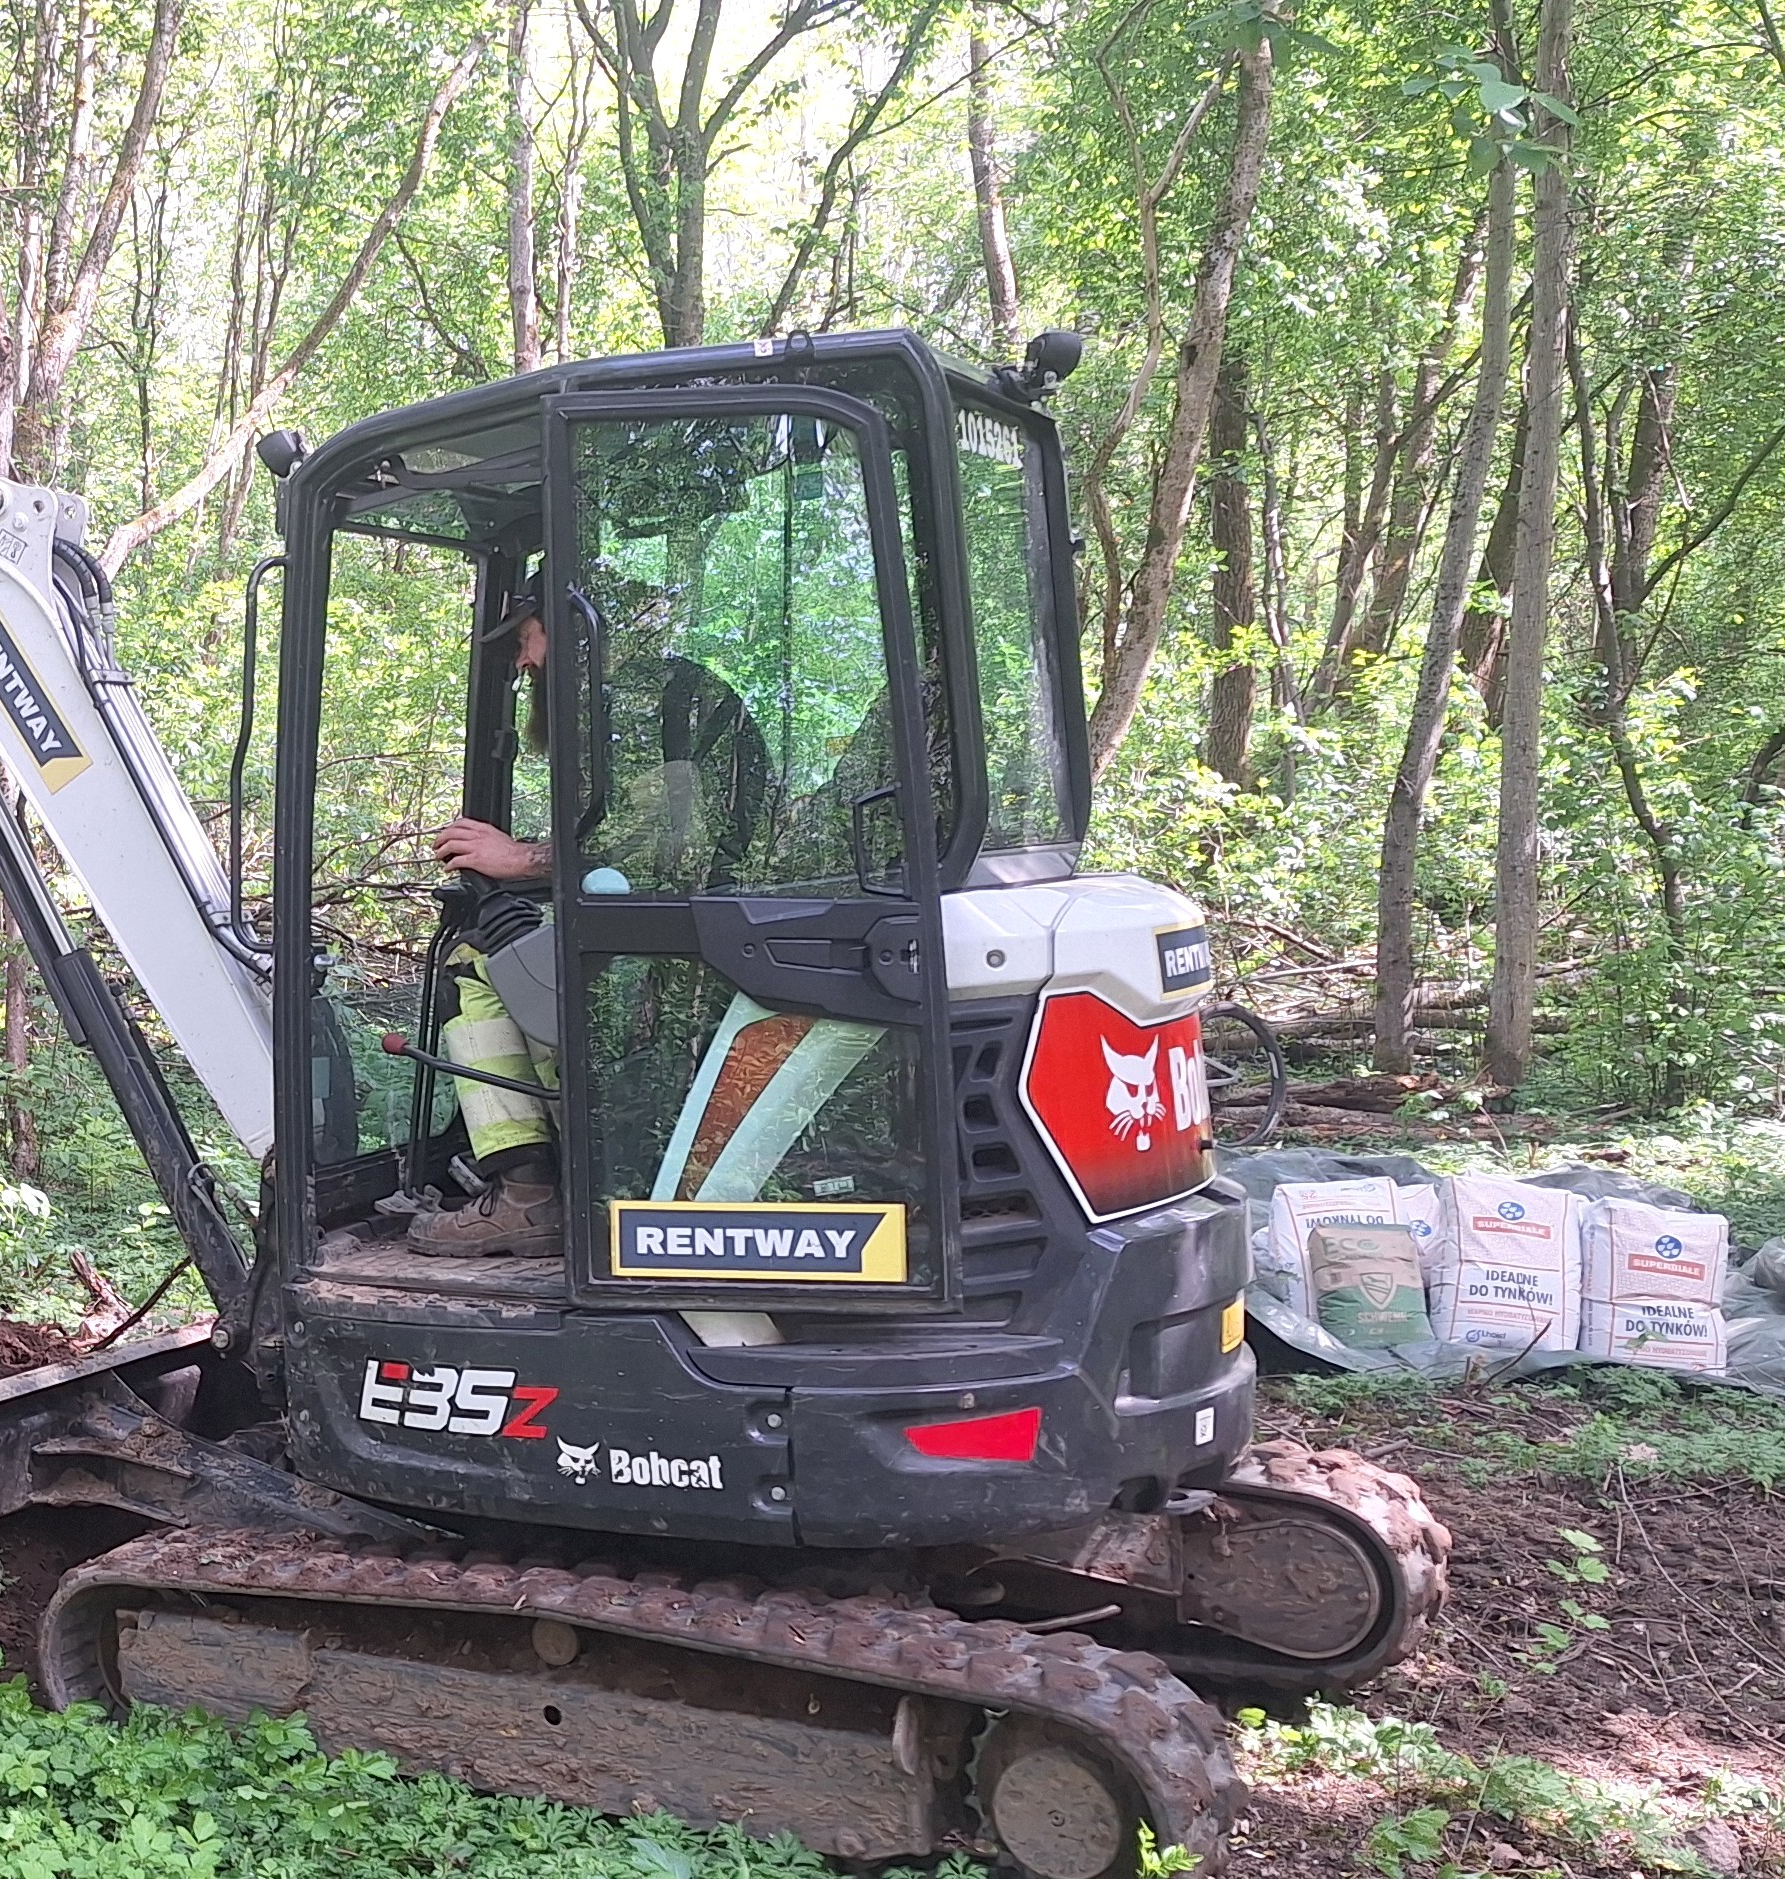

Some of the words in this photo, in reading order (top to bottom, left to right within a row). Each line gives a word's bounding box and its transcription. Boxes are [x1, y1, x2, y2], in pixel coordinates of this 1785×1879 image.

[636, 1226, 857, 1260] RENTWAY
[1486, 1270, 1539, 1287] IDEALNE
[1469, 1284, 1489, 1297] DO
[1642, 1305, 1694, 1319] IDEALNE
[1626, 1320, 1645, 1333] DO
[1651, 1320, 1707, 1337] TYNKÓW!
[608, 1448, 724, 1491] Bobcat
